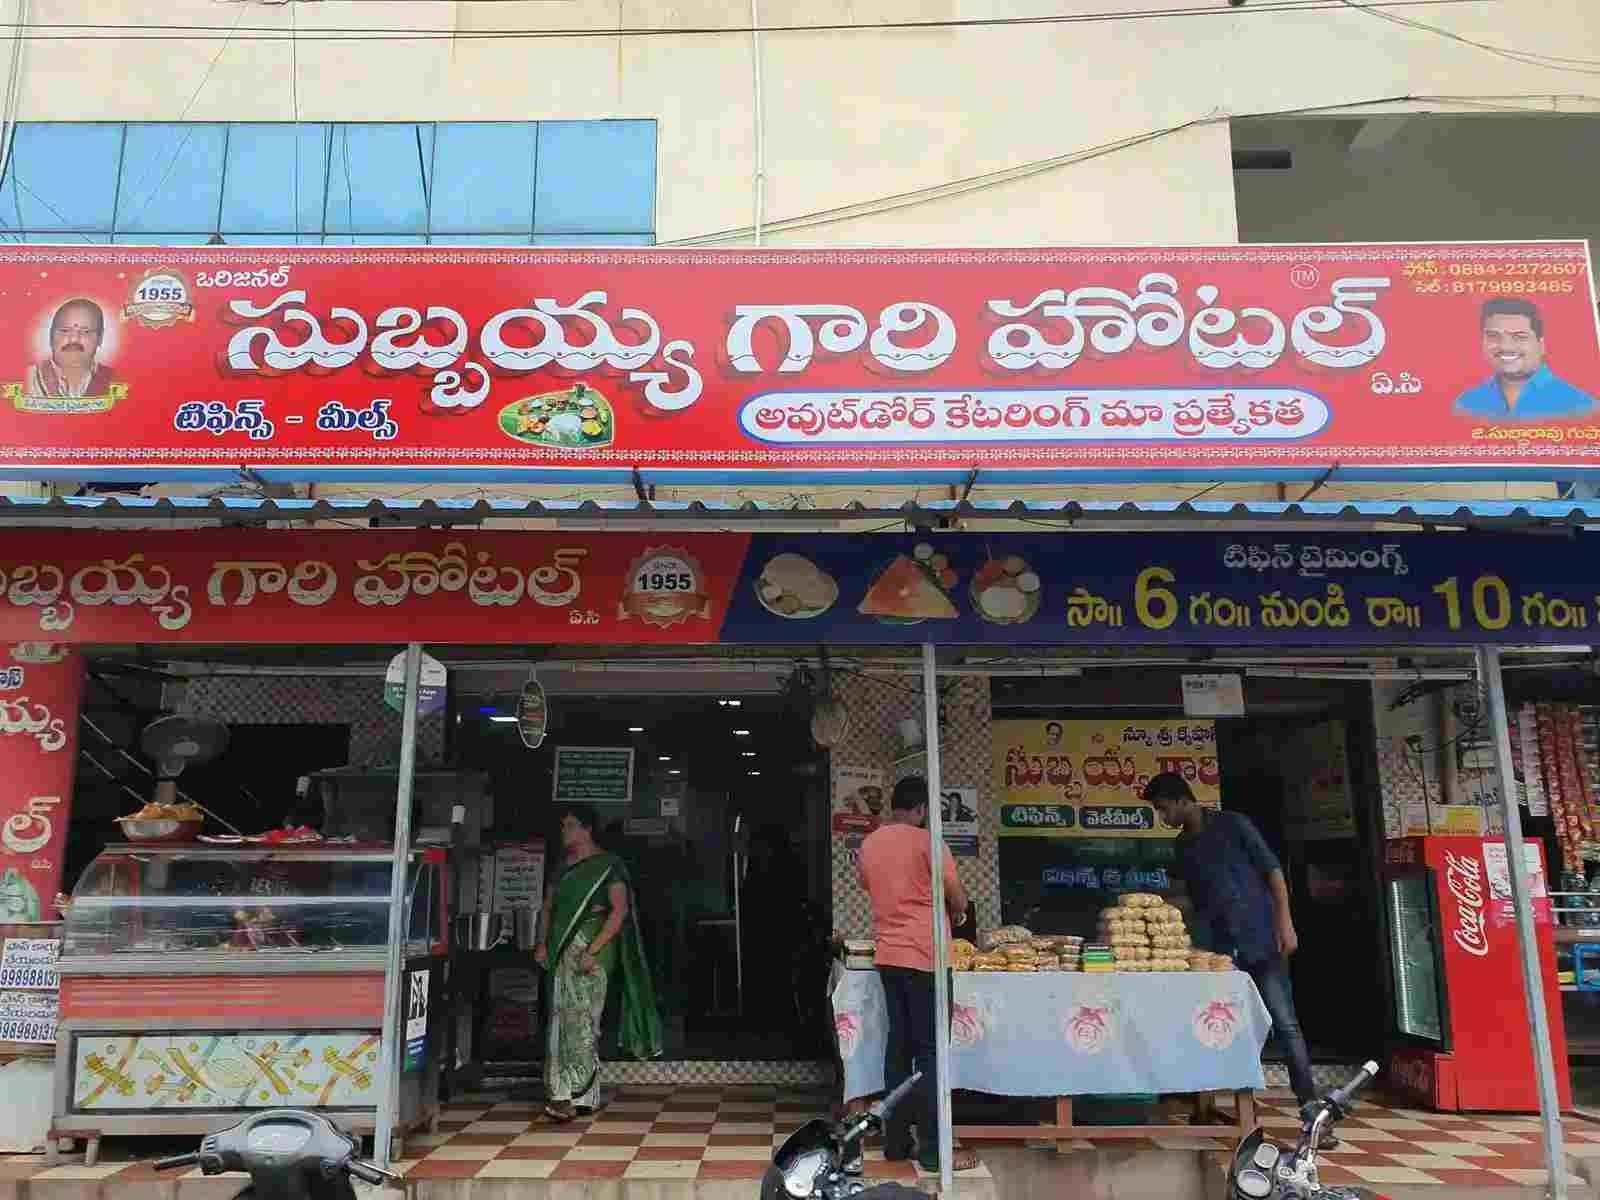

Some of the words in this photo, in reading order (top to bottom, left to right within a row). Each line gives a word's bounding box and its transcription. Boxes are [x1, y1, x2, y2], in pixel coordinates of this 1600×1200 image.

[137, 287, 183, 301] 1955
[226, 290, 703, 411] సుబ్బయ్య
[726, 300, 958, 373] గారి
[987, 272, 1391, 370] హోటల్
[174, 398, 274, 439] టిఫిన్స్
[317, 398, 399, 439] మీల్స్
[944, 396, 1091, 431] కేటరింగ్
[1100, 402, 1163, 427] మా
[1172, 394, 1306, 437] ప్రత్యేకత
[0, 553, 192, 630] బ్బయ్య
[207, 561, 337, 605] గారి
[352, 541, 588, 606] హోటల్
[638, 573, 691, 590] 1955
[1134, 567, 1178, 629] 6
[1260, 587, 1351, 627] నుండి
[1433, 575, 1512, 630] 10
[1445, 850, 1490, 956] Coca-Cola
